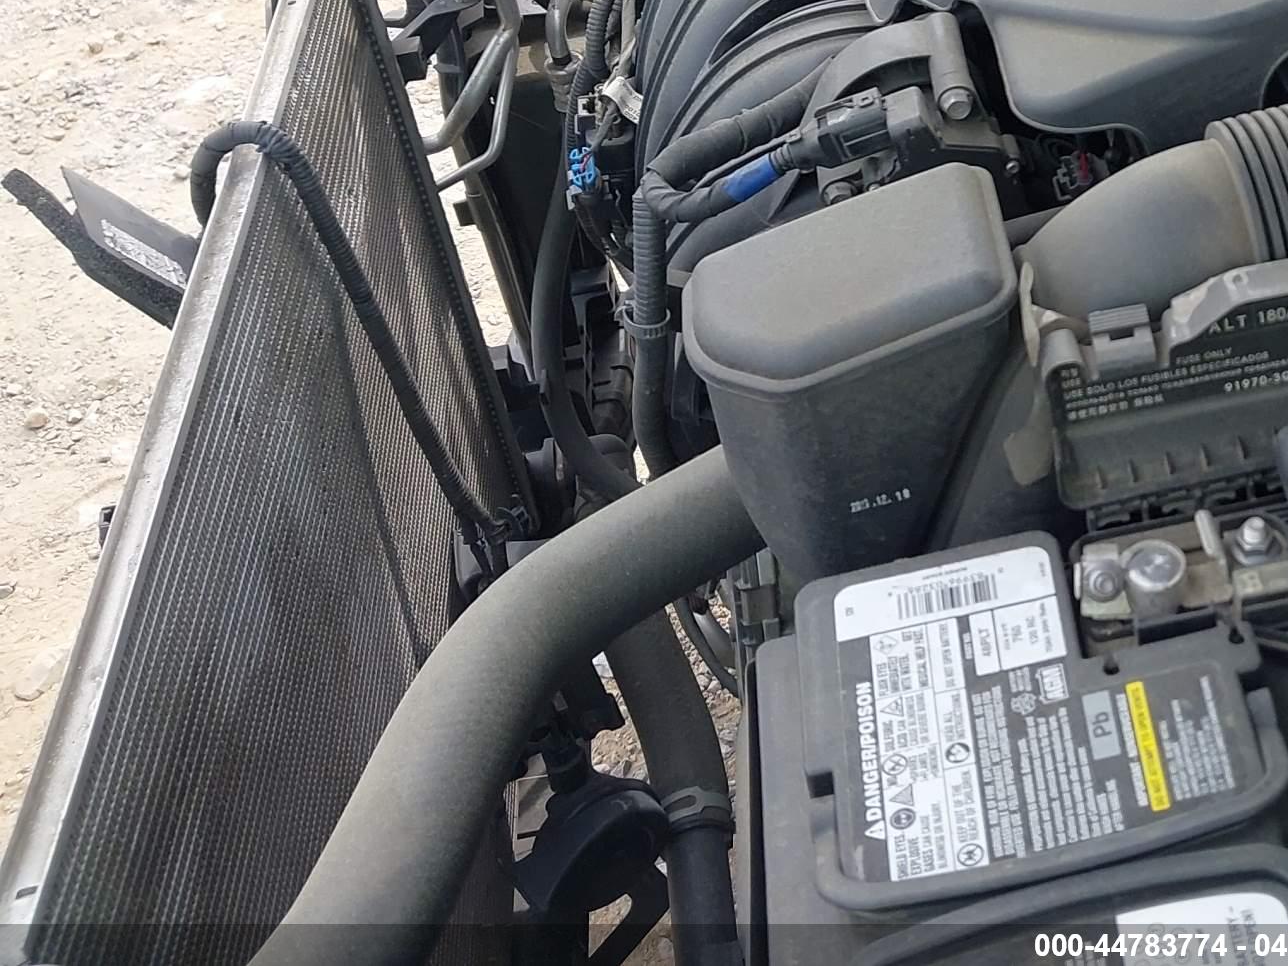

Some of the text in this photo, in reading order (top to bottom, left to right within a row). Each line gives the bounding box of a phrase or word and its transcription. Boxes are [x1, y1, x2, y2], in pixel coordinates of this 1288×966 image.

[1209, 314, 1247, 334] ALT
[1086, 381, 1116, 395] SOLO
[1118, 377, 1138, 390] LOS
[1141, 366, 1188, 384] FUSIBLES
[1042, 666, 1063, 700] AGM
[1091, 710, 1112, 738] Pb
[854, 680, 883, 821] DANGER/POISON
